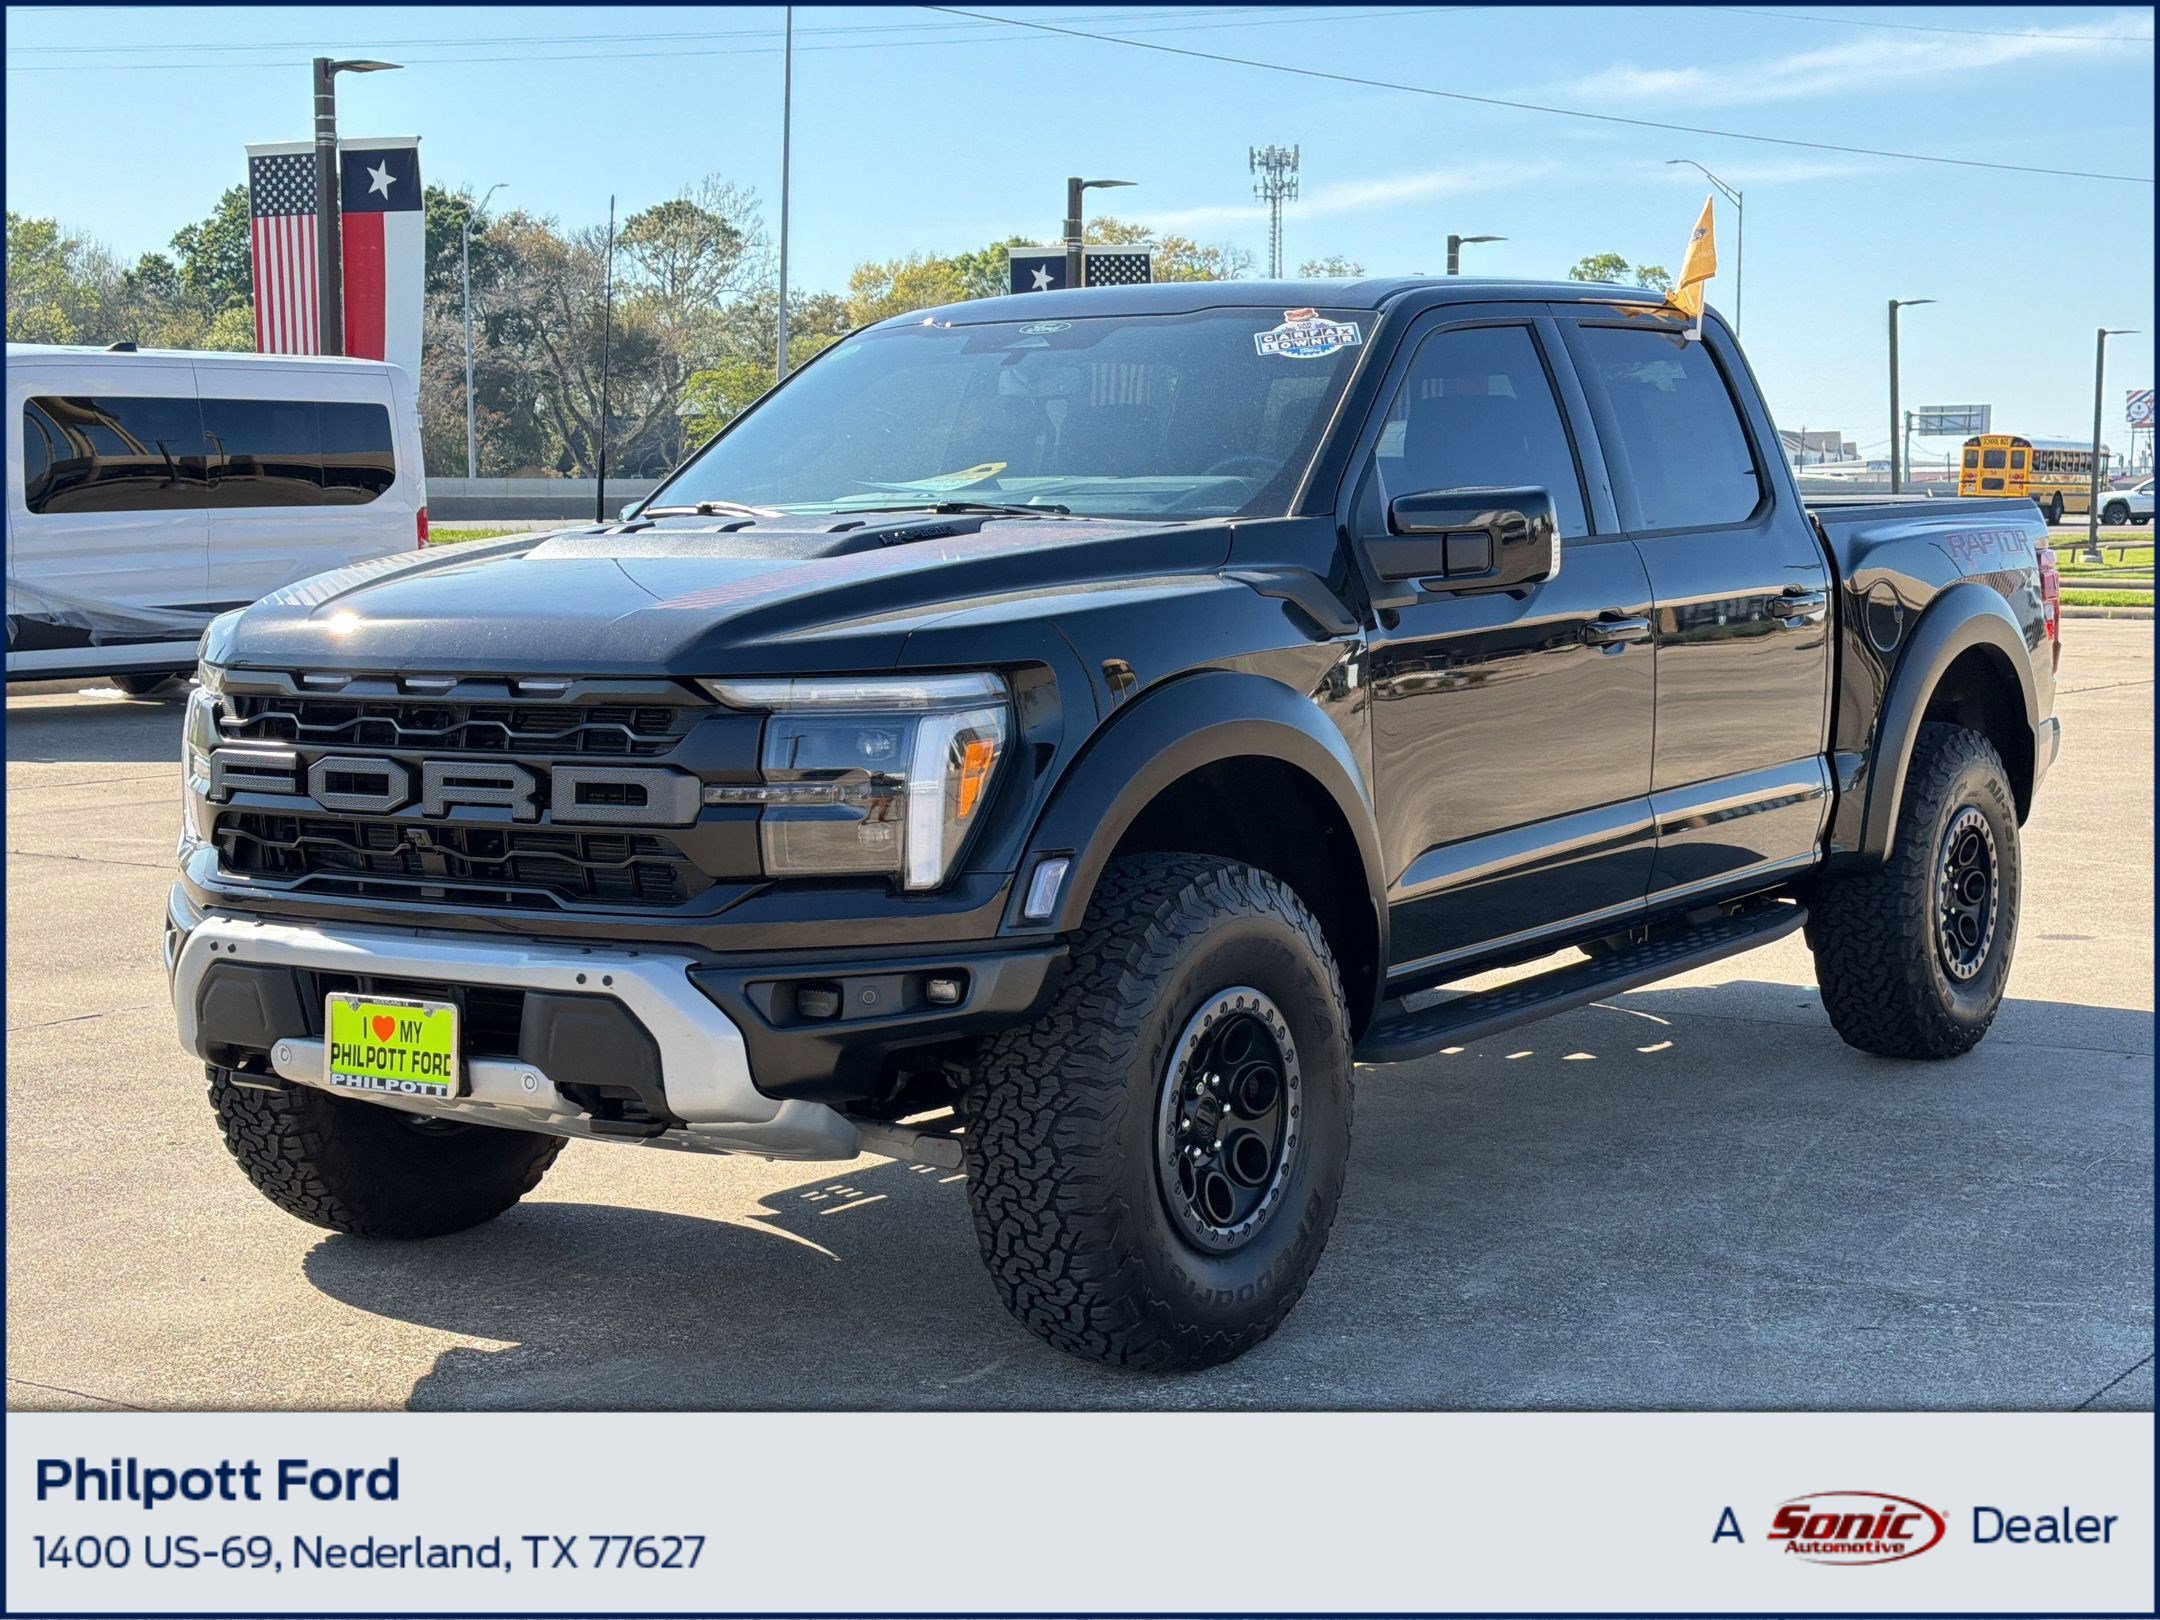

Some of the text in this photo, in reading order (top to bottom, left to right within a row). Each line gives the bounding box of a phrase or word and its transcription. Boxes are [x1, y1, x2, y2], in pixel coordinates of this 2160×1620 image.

[1263, 328, 1350, 342] CARFAX
[1279, 335, 1353, 349] OWNER
[1945, 530, 2031, 564] RAPTOR
[209, 750, 701, 825] FORD
[363, 1016, 422, 1044] I MY
[331, 1042, 451, 1076] PHILPOTT FORD
[331, 1073, 447, 1096] PHILPOTT
